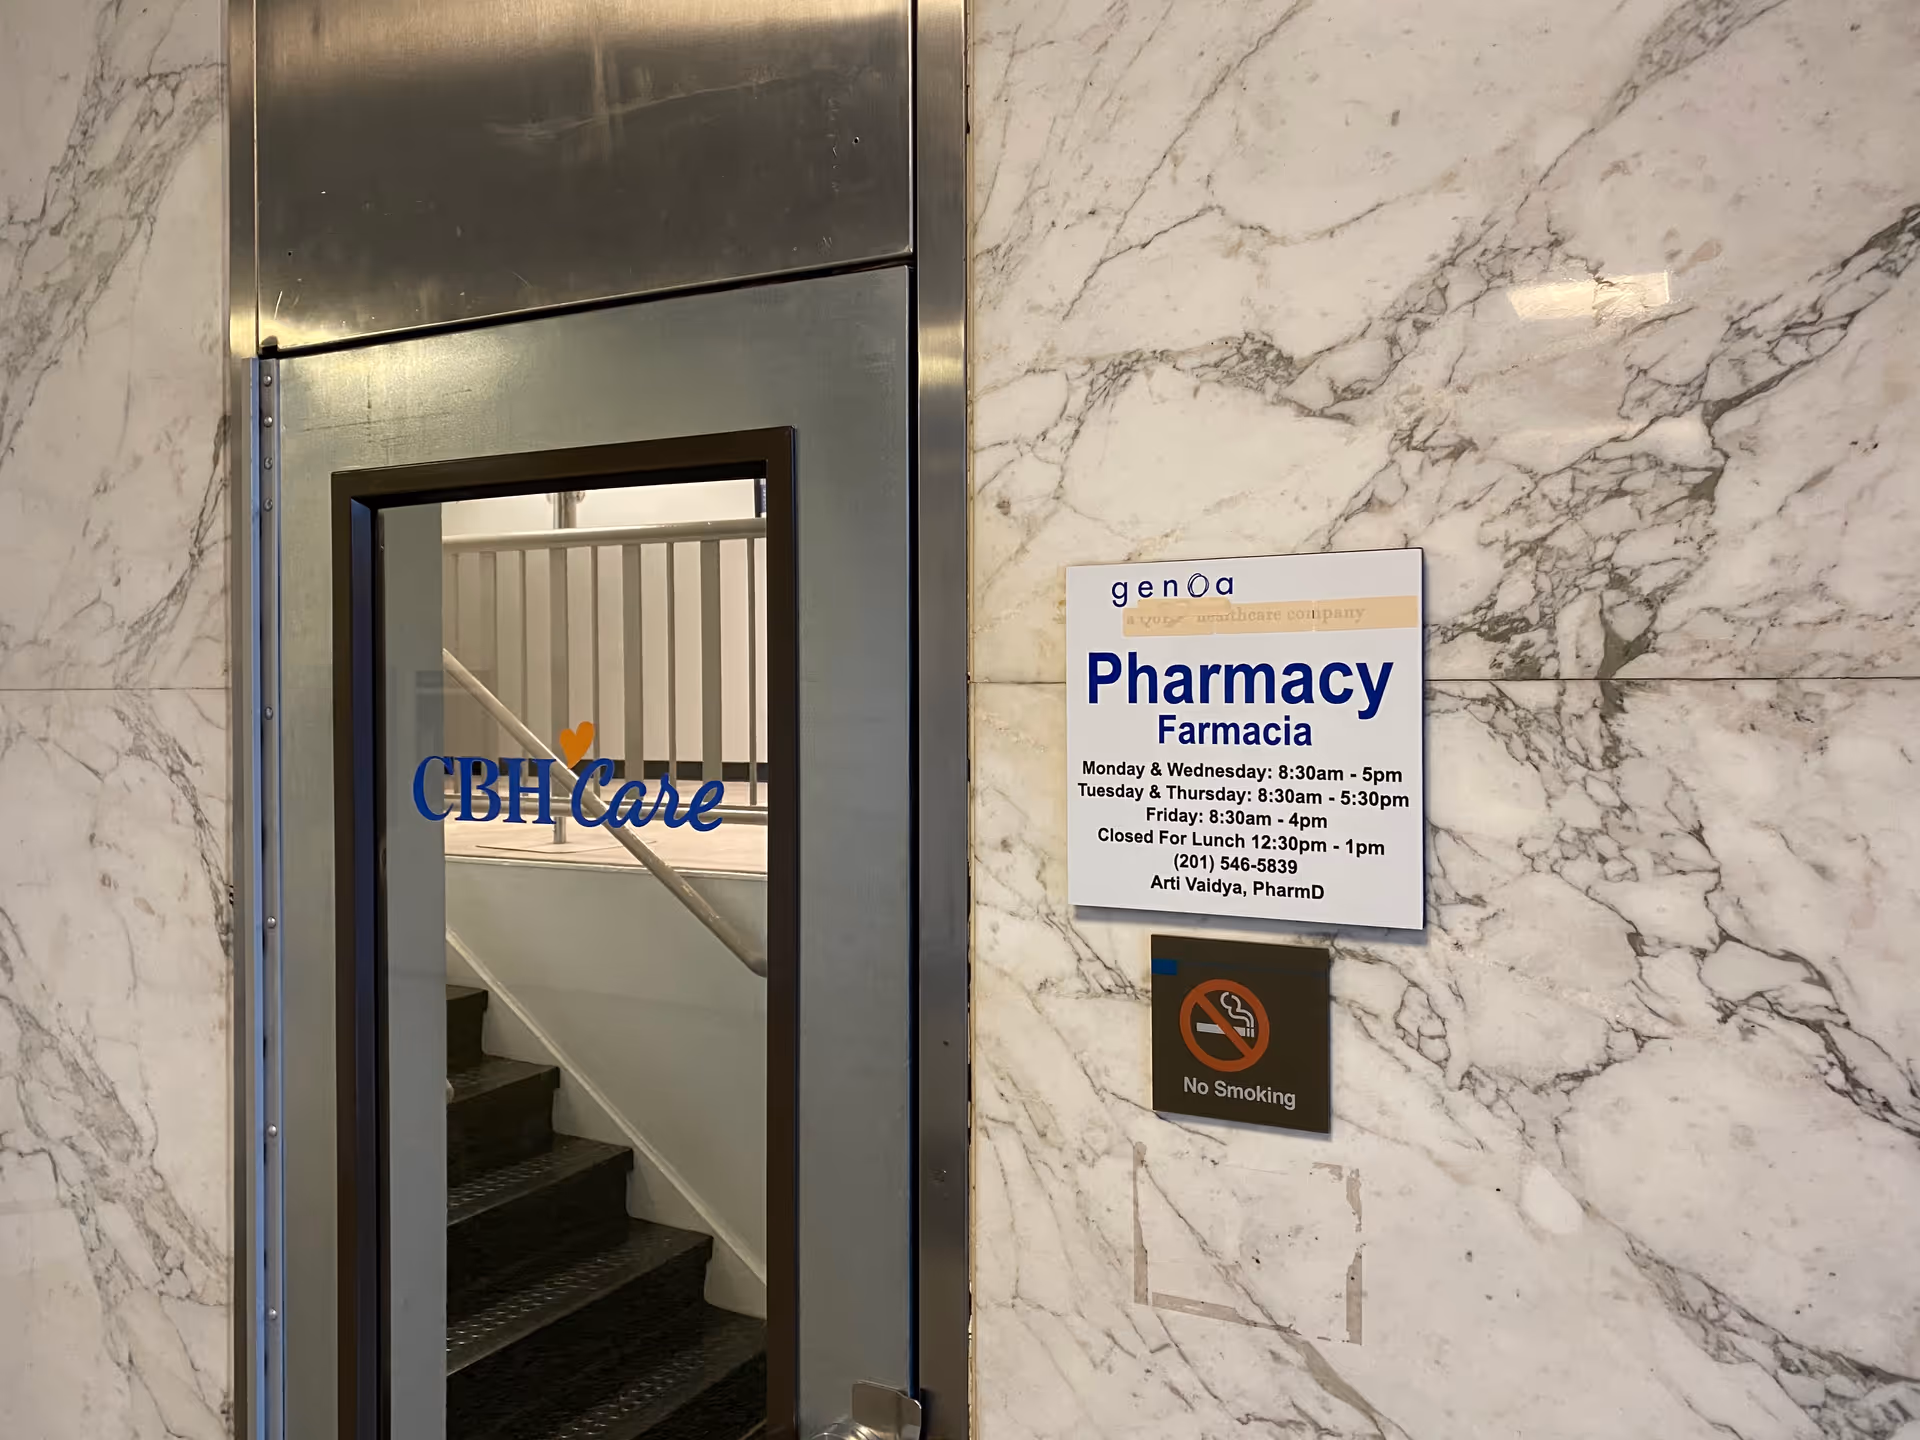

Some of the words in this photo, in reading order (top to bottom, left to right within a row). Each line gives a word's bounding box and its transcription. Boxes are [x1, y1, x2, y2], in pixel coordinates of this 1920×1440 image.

[1287, 607, 1366, 624] company
[1089, 651, 1393, 720] Pharmacy
[1159, 714, 1312, 746] Farmacia
[1083, 760, 1145, 780] Monday
[1150, 762, 1163, 777] &
[1167, 763, 1272, 783] Wednesday:
[1279, 765, 1344, 781] 8:30am
[1362, 767, 1403, 786] 5pm
[413, 755, 557, 825] CBH
[571, 757, 725, 832] Care
[1078, 782, 1144, 802] Tuesday
[1149, 784, 1162, 799] &
[1166, 785, 1252, 806] Thursday:
[1258, 788, 1322, 805] 8:30am
[1341, 791, 1409, 811] 5:30pm
[1146, 807, 1203, 827] Friday:
[1209, 809, 1272, 827] 8:30am
[1289, 812, 1328, 832] 4pm
[1098, 828, 1153, 845] Closed
[1159, 830, 1188, 846] For
[1192, 832, 1245, 850] Lunch
[1251, 835, 1327, 856] 12:30pm
[1345, 839, 1385, 859] 1pm
[1174, 853, 1214, 873] (201)
[1221, 856, 1298, 875] 546-5839
[1151, 875, 1181, 891] Arti
[1185, 877, 1247, 898] Vaidya,
[1253, 881, 1325, 901] PharmD
[1183, 1076, 1209, 1095] No
[1214, 1080, 1296, 1111] Smoking
